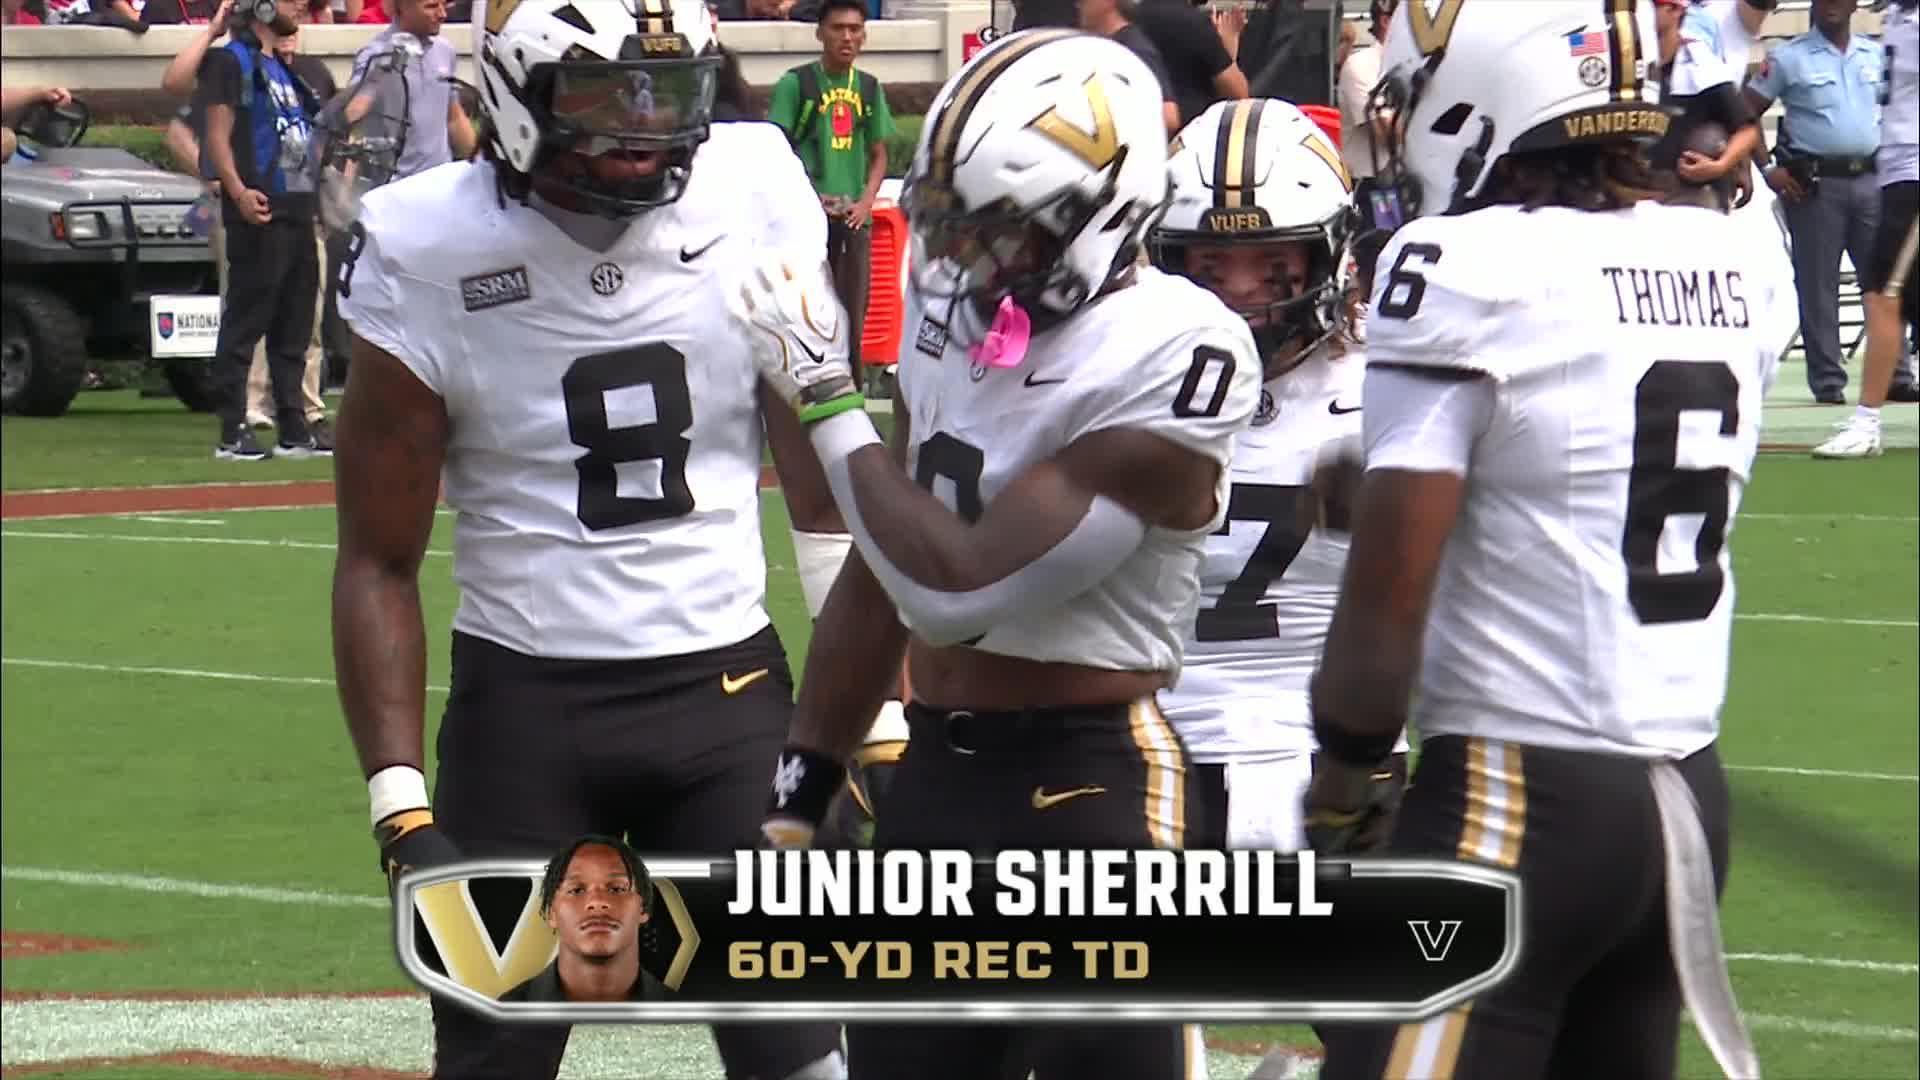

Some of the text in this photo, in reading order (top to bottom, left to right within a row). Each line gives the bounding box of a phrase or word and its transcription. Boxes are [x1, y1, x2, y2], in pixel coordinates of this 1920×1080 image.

[1210, 213, 1261, 231] VUFB
[1379, 242, 1443, 320] 6
[1601, 266, 1750, 329] THOMAS
[1171, 344, 1236, 418] 0
[562, 341, 696, 531] 8
[1622, 360, 1740, 624] 6
[1195, 482, 1313, 642] 7
